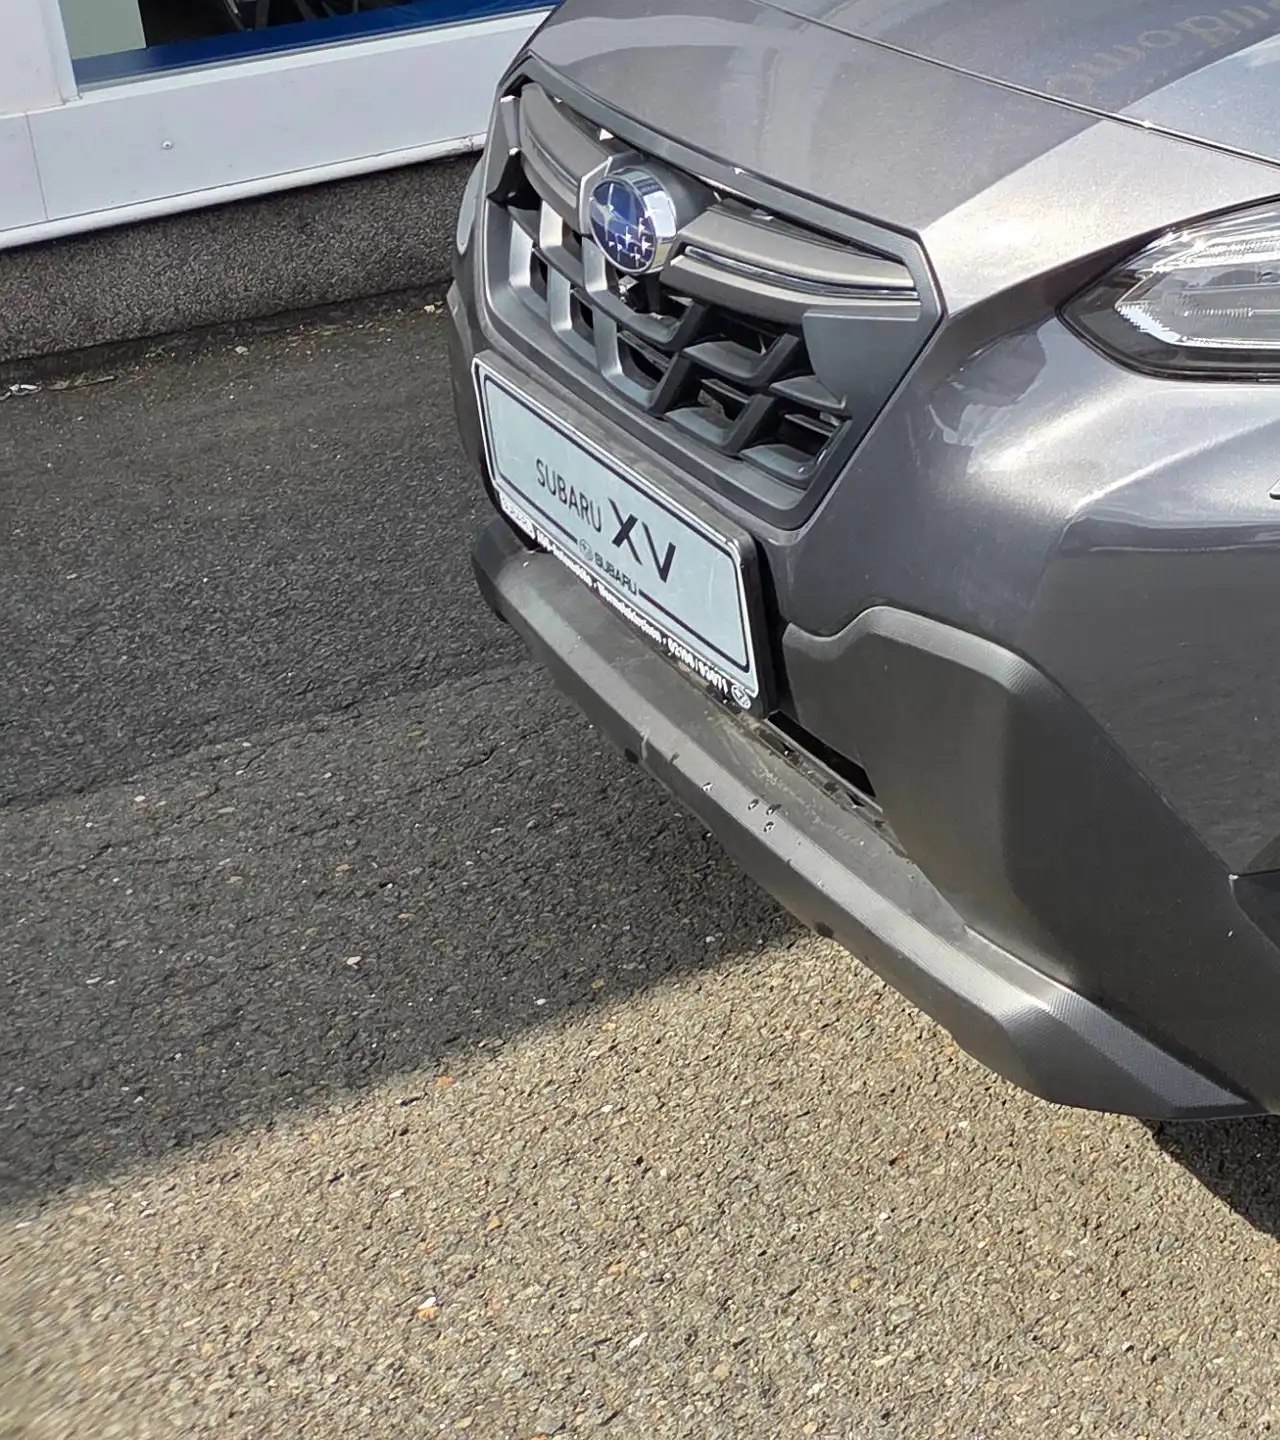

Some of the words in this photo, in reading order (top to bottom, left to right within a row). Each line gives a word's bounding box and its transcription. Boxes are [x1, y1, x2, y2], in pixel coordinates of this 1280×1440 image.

[535, 458, 603, 534] SUBARU
[608, 497, 677, 584] XV
[593, 551, 638, 597] SUBARU
